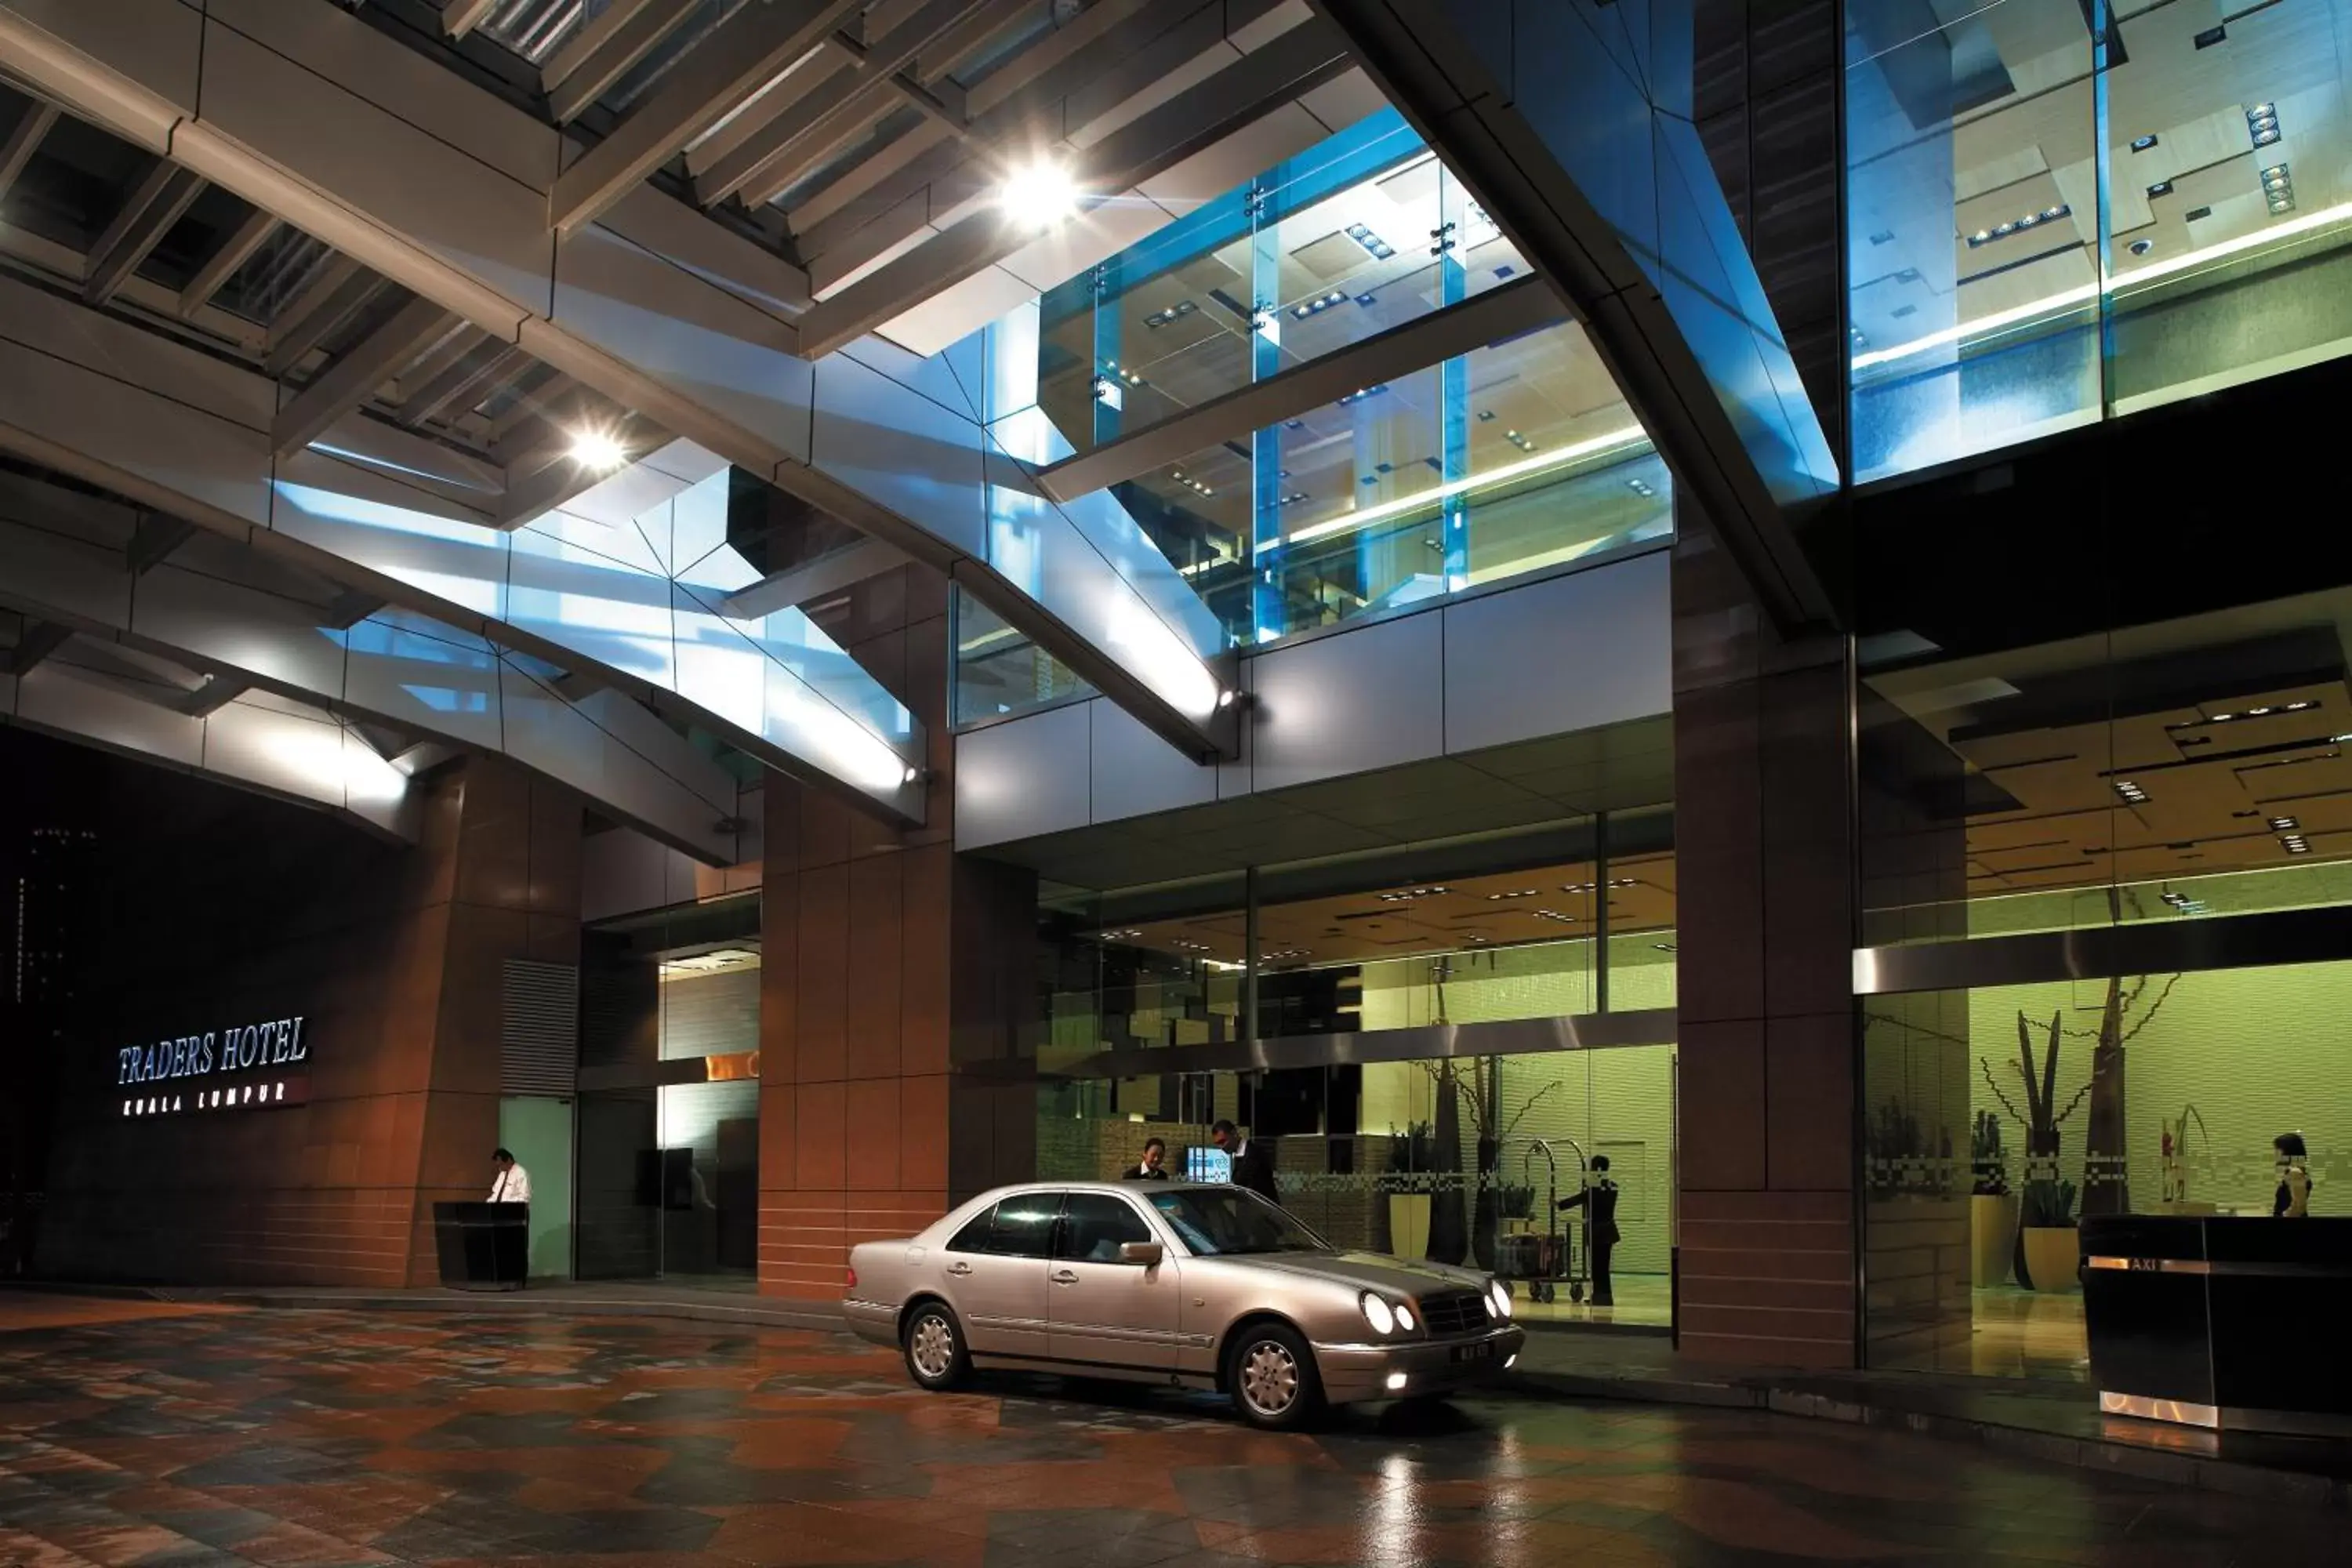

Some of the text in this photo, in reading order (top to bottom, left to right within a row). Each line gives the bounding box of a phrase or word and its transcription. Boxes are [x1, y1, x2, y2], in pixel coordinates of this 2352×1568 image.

[118, 1017, 307, 1084] TRADERS HOTEL
[123, 1082, 285, 1116] KUALA LUMPUR
